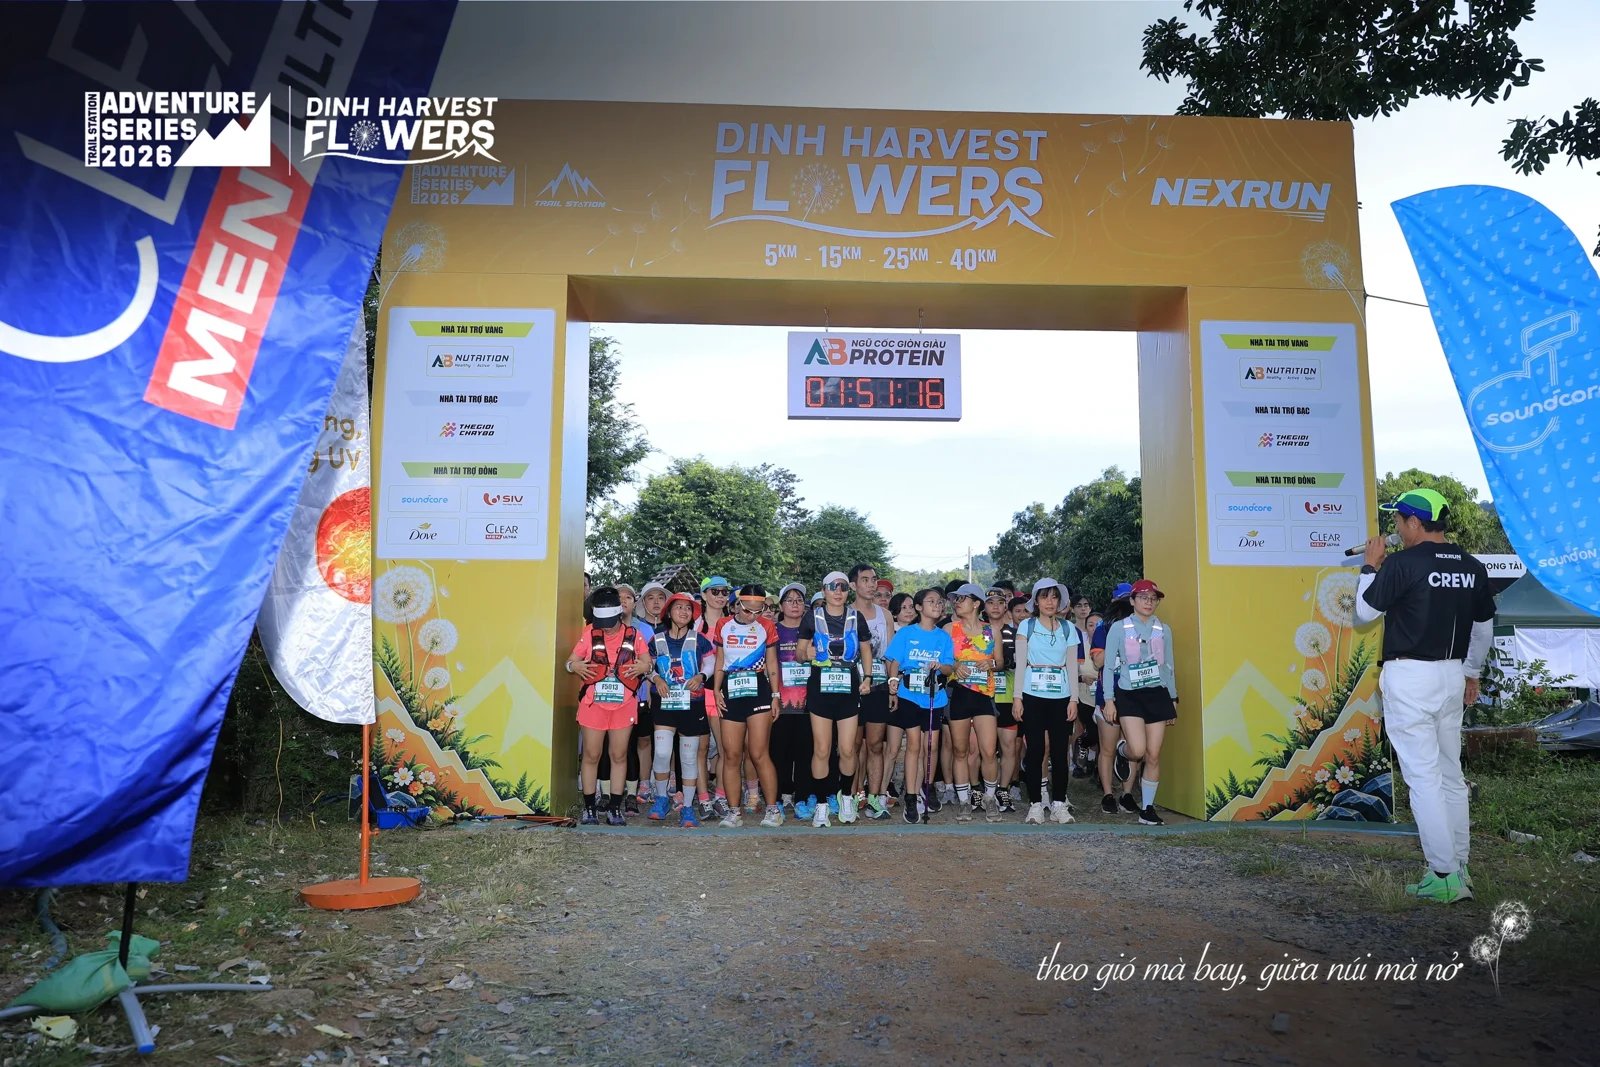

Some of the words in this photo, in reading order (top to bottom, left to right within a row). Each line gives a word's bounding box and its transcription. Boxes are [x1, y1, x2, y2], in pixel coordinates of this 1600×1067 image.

[716, 122, 826, 156] DINH
[842, 126, 1048, 161] HARVEST
[421, 165, 506, 178] ADVENTURE
[421, 178, 474, 191] SERIES
[420, 192, 460, 204] 2026
[1150, 178, 1331, 210] NEXRUN
[765, 244, 797, 266] 5KM
[818, 246, 862, 268] 15KM
[883, 247, 928, 269] 25KM
[950, 248, 997, 271] 40KM
[167, 166, 294, 406] MEN
[851, 338, 872, 347] NGŨ
[874, 337, 896, 348] CỐC
[897, 338, 921, 348] GIÒN
[922, 339, 946, 348] GIÀU
[804, 338, 848, 365] AB
[849, 349, 945, 366] PROTEIN
[432, 354, 453, 367] AB
[1245, 366, 1264, 380] AB
[806, 378, 944, 408] 01:51:16
[1486, 385, 1600, 426] soundcor
[325, 415, 362, 440] ng,
[329, 446, 361, 470] UV
[402, 495, 448, 504] soundcore
[1228, 503, 1272, 512] soundcore
[409, 529, 437, 540] Dove
[485, 523, 518, 534] CLEAR
[1238, 537, 1264, 548] Dove
[1310, 532, 1341, 542] CLEAR
[1508, 561, 1522, 570] TÀI
[1428, 572, 1476, 588] CREW
[727, 635, 758, 645] STC
[1138, 668, 1153, 676] F5021
[734, 678, 750, 686] F5114
